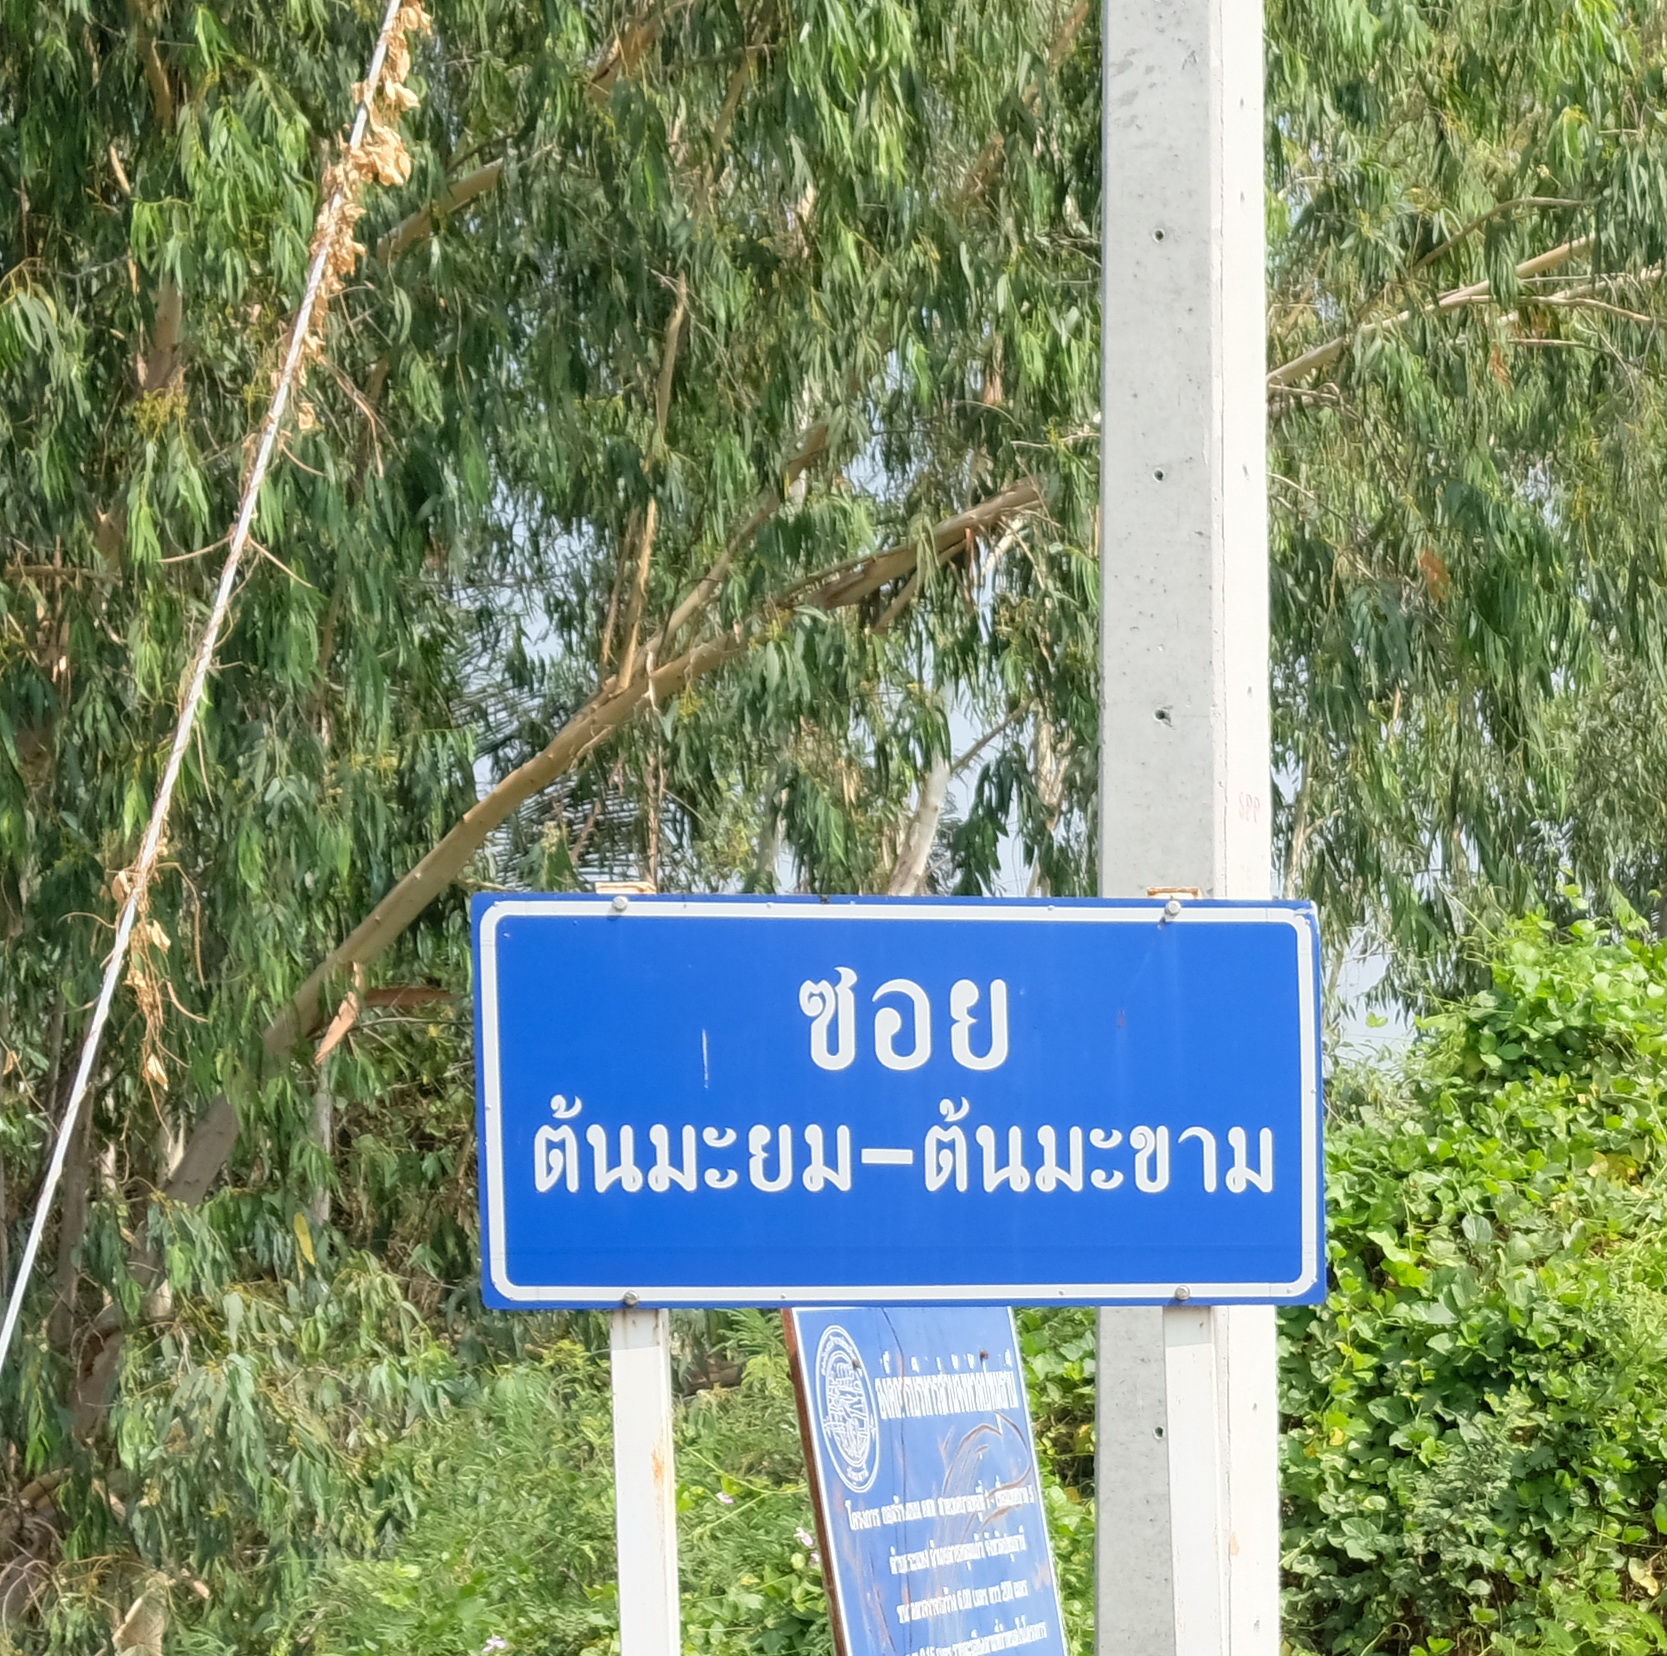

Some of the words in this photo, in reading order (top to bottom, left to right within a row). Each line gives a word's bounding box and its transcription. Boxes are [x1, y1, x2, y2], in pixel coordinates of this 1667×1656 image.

[799, 966, 1009, 1071] ซอย
[534, 1094, 1274, 1194] ต้นมะยม-ต้นมะขาม
